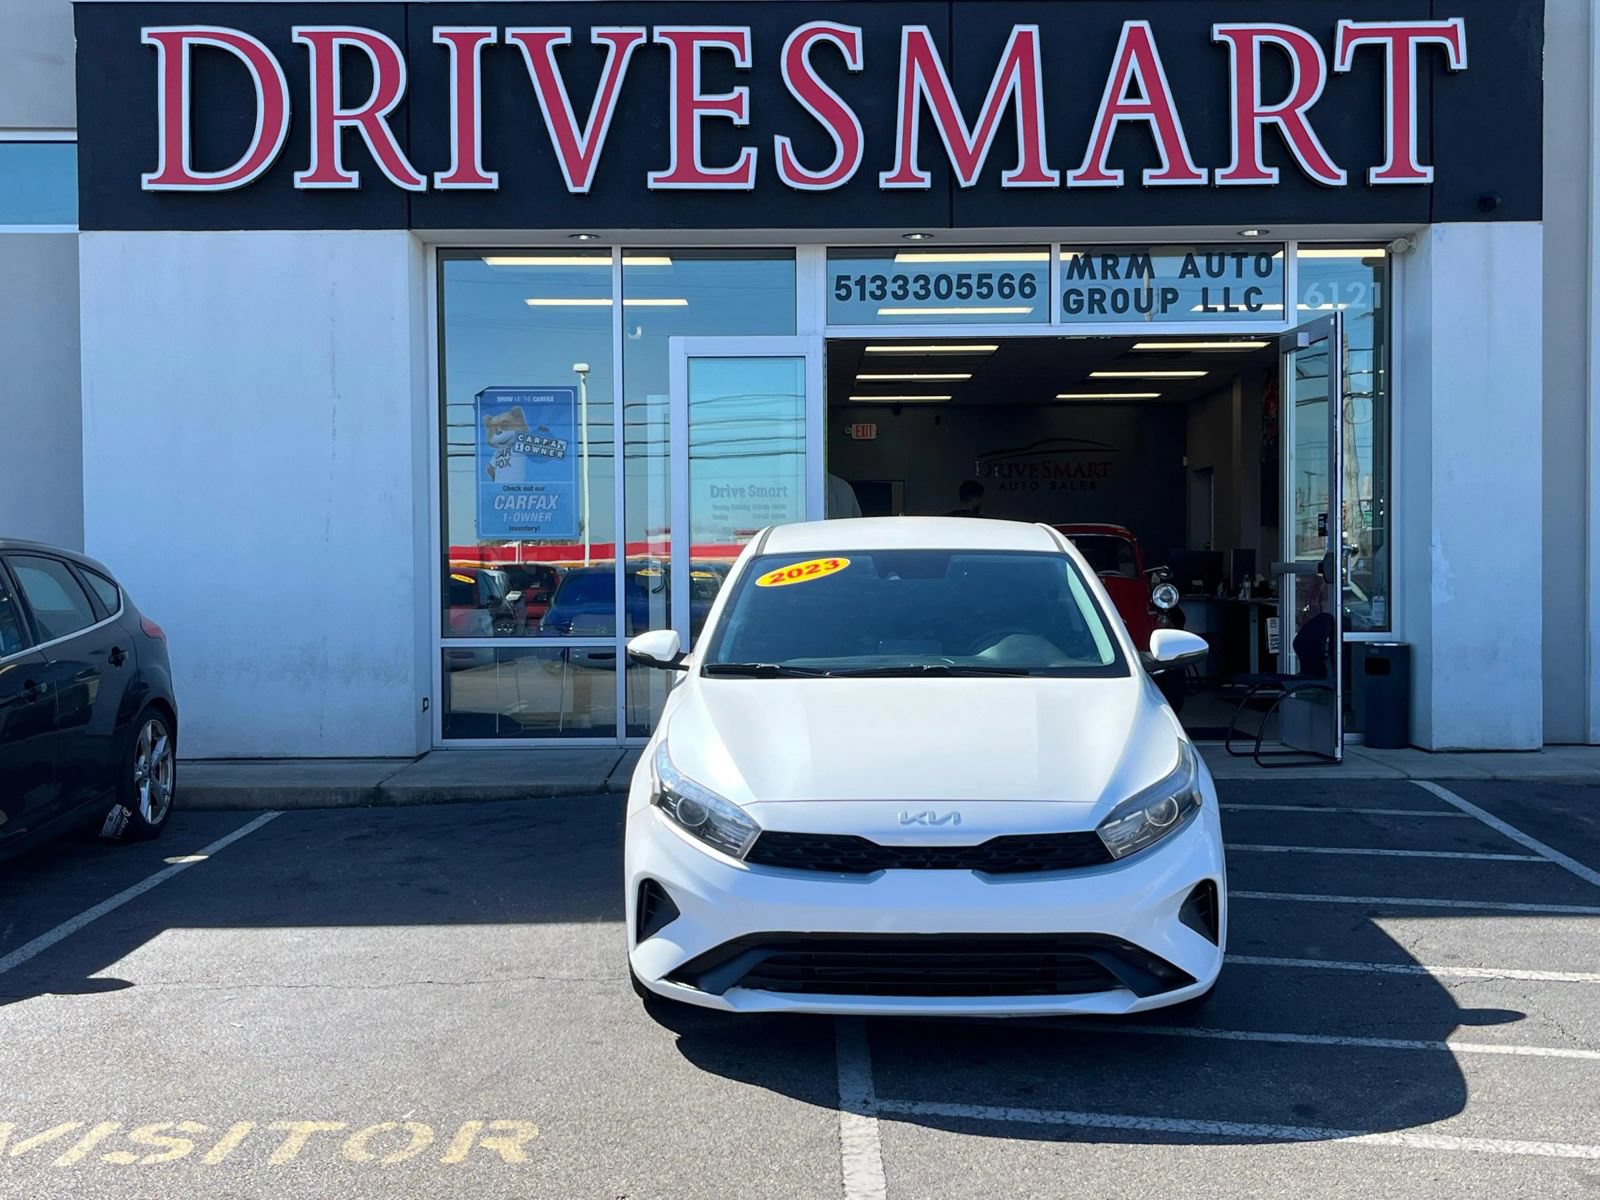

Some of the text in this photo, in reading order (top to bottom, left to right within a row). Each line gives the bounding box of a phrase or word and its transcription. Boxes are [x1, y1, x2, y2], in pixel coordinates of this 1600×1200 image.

[140, 18, 1468, 194] DRIVESMART
[1066, 251, 1273, 280] MRM AUTO
[834, 272, 1038, 302] 5133305566
[1303, 281, 1381, 309] 6121
[1062, 286, 1264, 315] GROUP LLC
[532, 395, 554, 403] CARFAX
[854, 424, 873, 438] EXIT
[517, 433, 567, 451] CARFAX
[710, 484, 788, 498] Drive Smart
[998, 480, 1097, 491] AUTO SALES
[494, 494, 559, 510] CARFAX
[503, 512, 553, 522] 1-OWNER
[769, 559, 840, 585] 2023
